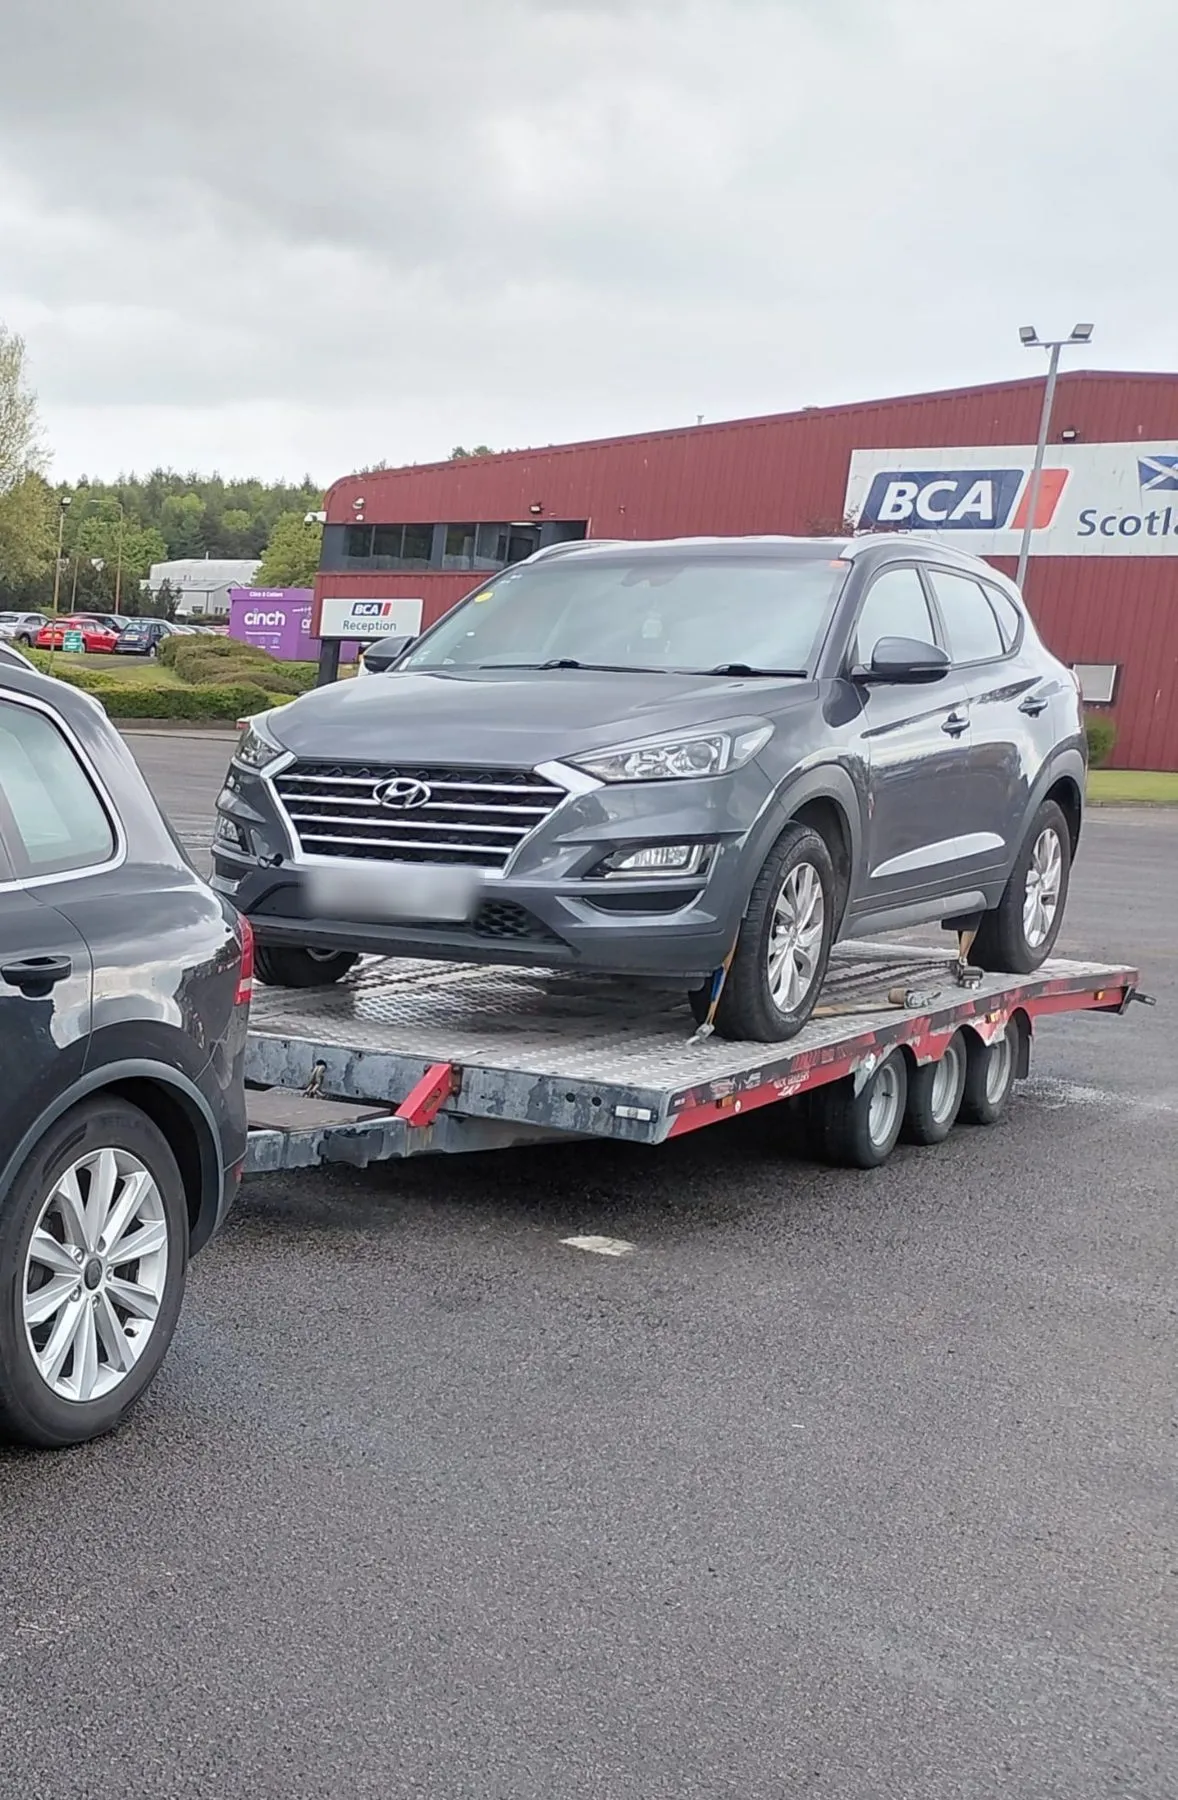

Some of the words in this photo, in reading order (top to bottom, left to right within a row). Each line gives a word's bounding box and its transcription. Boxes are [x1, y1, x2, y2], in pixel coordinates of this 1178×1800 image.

[877, 480, 993, 521] BCA
[1077, 506, 1178, 536] Scotl
[244, 608, 286, 626] cinch
[354, 603, 379, 615] BCA
[342, 620, 397, 633] Reception
